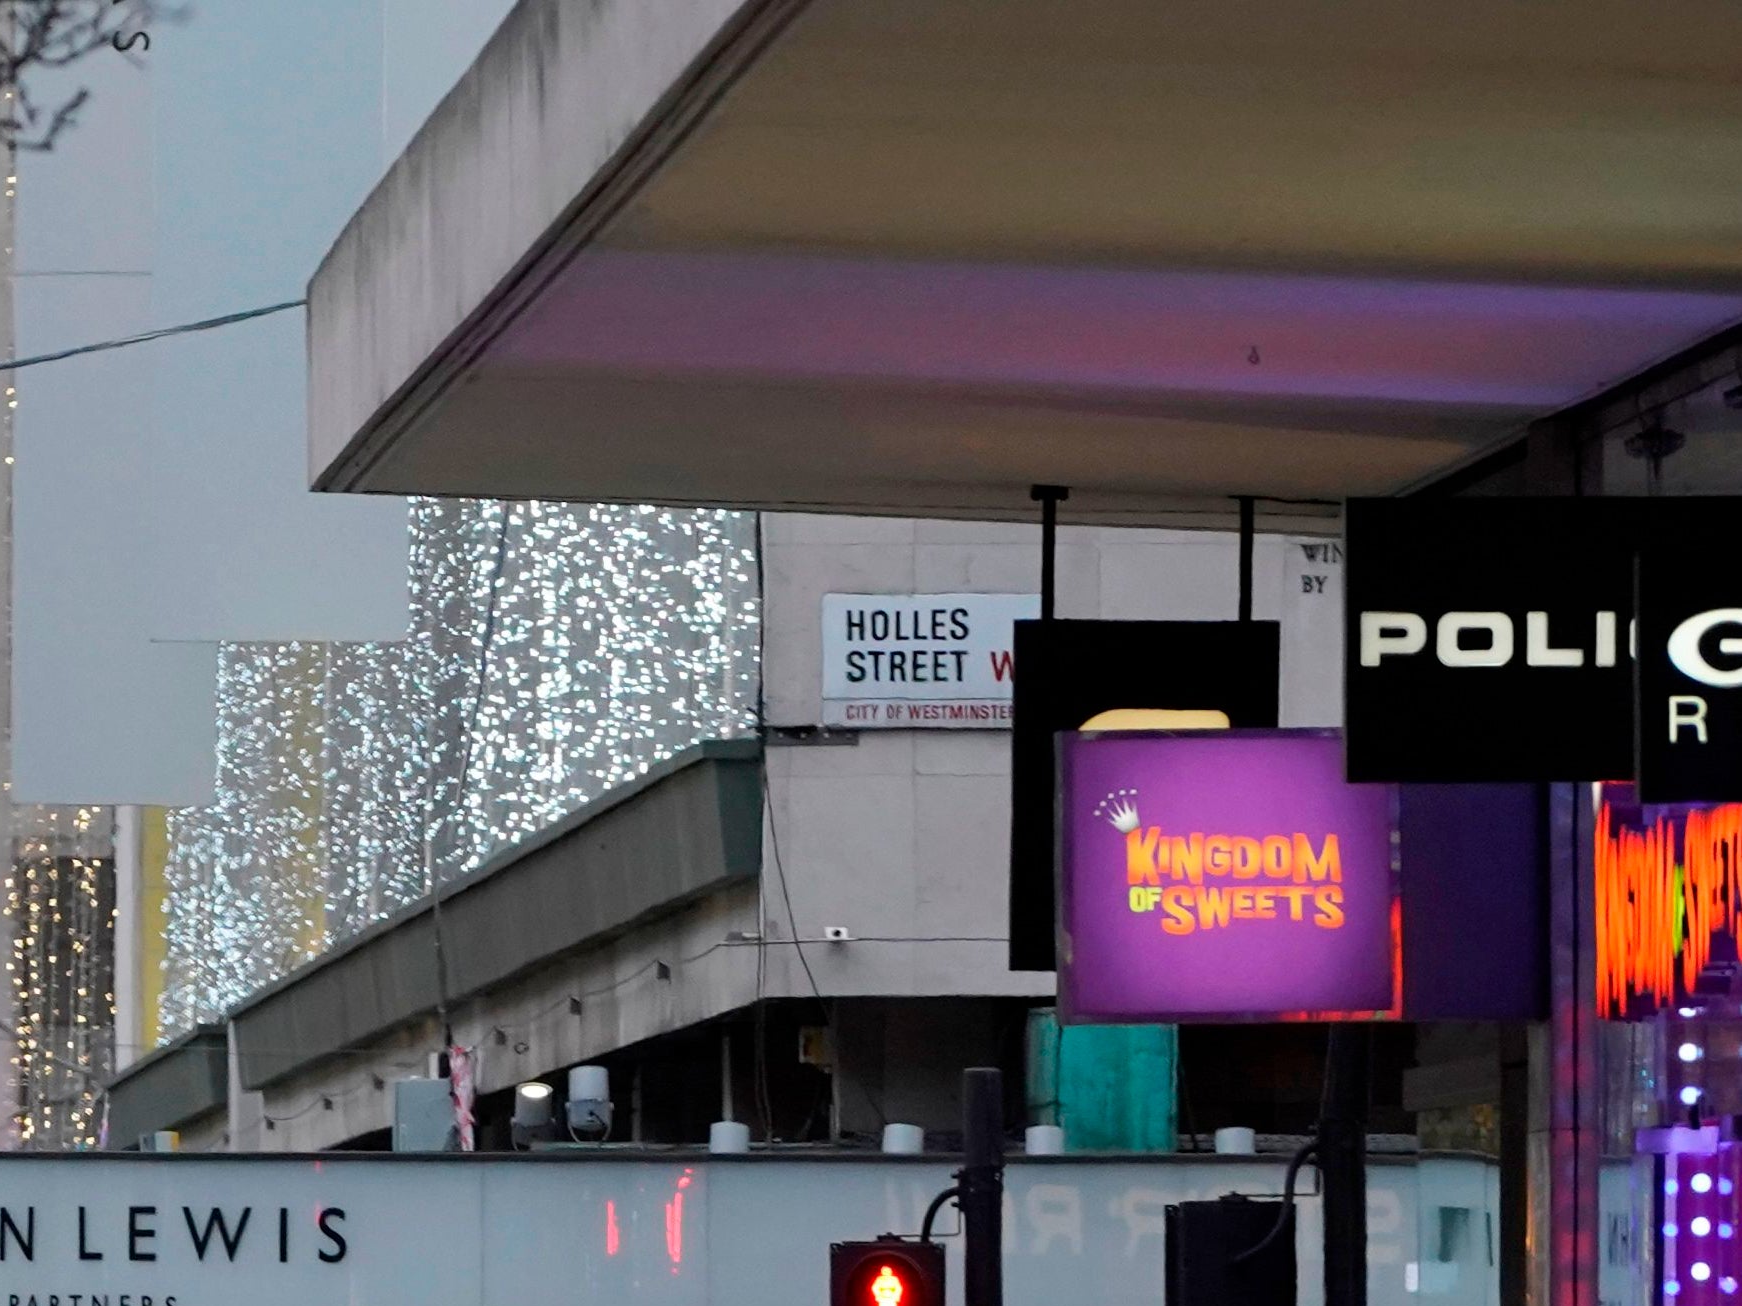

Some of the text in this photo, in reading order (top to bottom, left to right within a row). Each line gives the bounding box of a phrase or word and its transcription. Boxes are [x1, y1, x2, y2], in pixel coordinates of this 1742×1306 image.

[1301, 574, 1328, 594] BY
[846, 608, 970, 641] HOLLES
[1360, 610, 1636, 667] POLI
[846, 650, 969, 682] STREET
[846, 704, 877, 720] CITY
[886, 704, 903, 720] OF
[1125, 826, 1343, 885] KINGDOM
[1128, 885, 1346, 936] OF SWEETS
[78, 1206, 348, 1263] LEWIS
